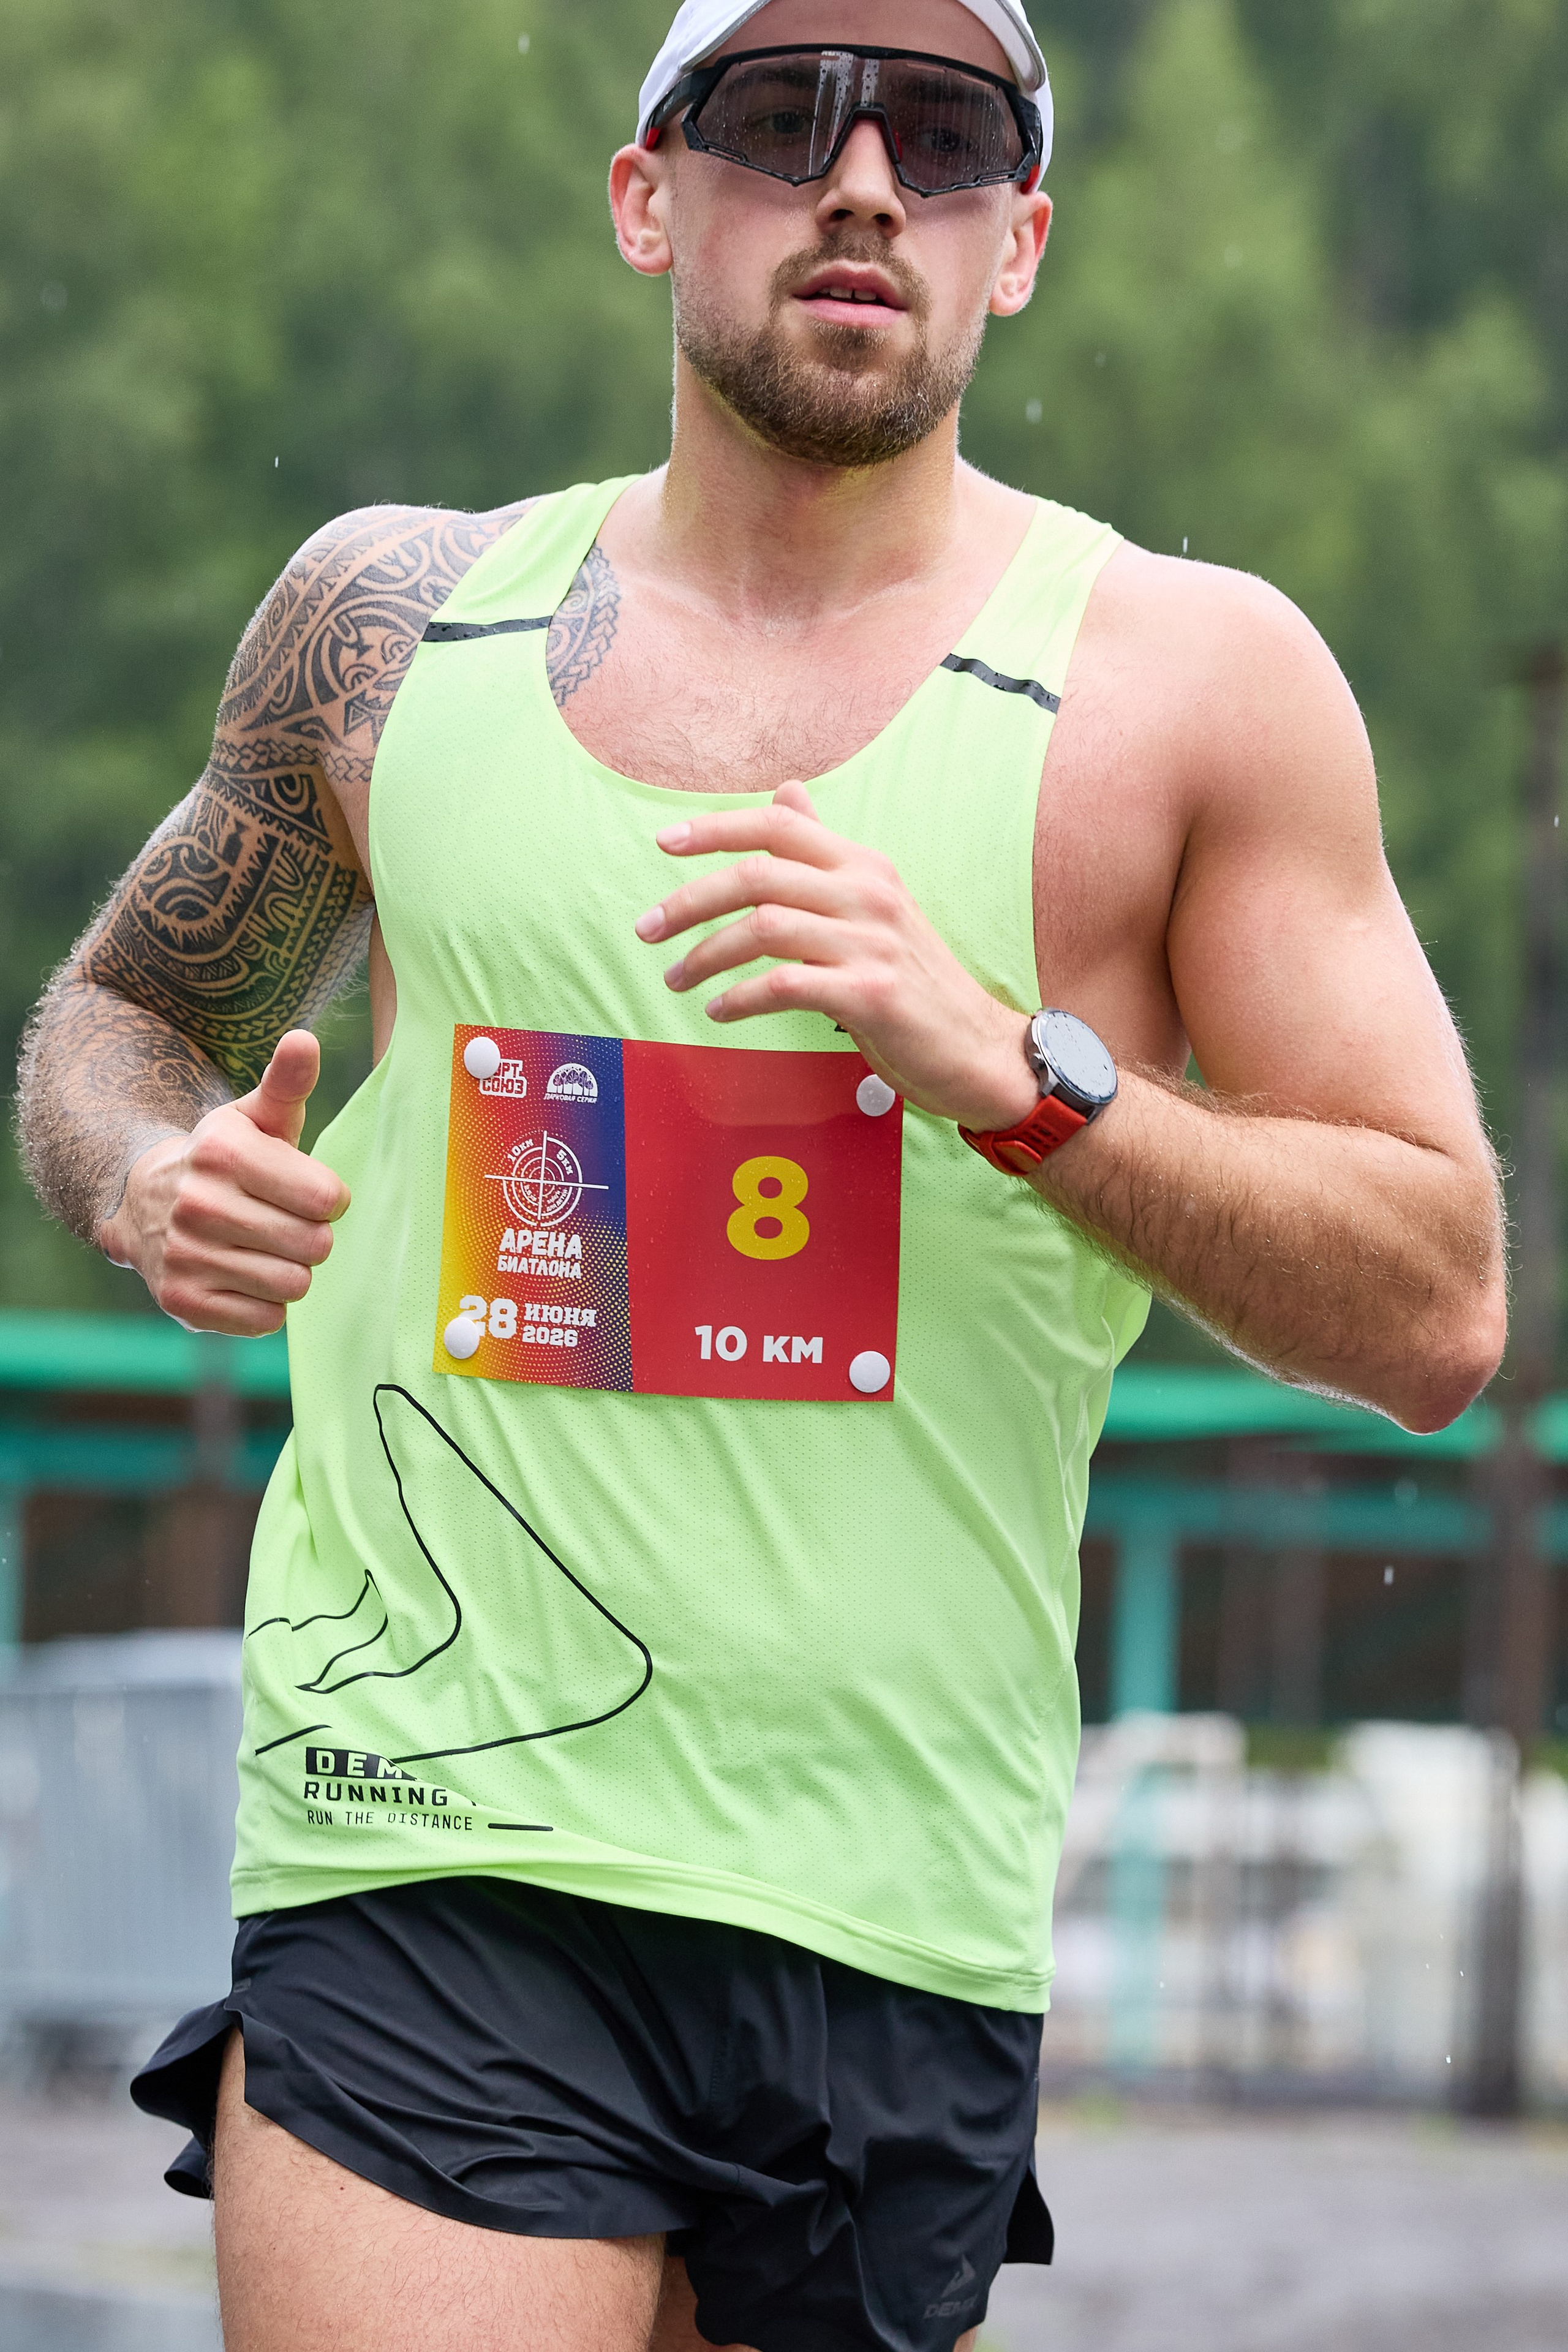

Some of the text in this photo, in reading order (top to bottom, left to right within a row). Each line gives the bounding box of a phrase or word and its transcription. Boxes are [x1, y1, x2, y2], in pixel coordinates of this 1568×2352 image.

[482, 1077, 524, 1095] СОЮЗ
[726, 1156, 810, 1260] 8
[499, 1227, 582, 1259] АРЕНА
[497, 1254, 582, 1279] БИАТЛОНА
[459, 1294, 597, 1339] 28 ИЮНЯ
[522, 1325, 578, 1348] 2026
[695, 1325, 748, 1362] 10
[316, 1750, 407, 1779] DEM
[304, 1781, 448, 1807] RUNNING
[307, 1810, 473, 1831] RUN THE DISTANCE
